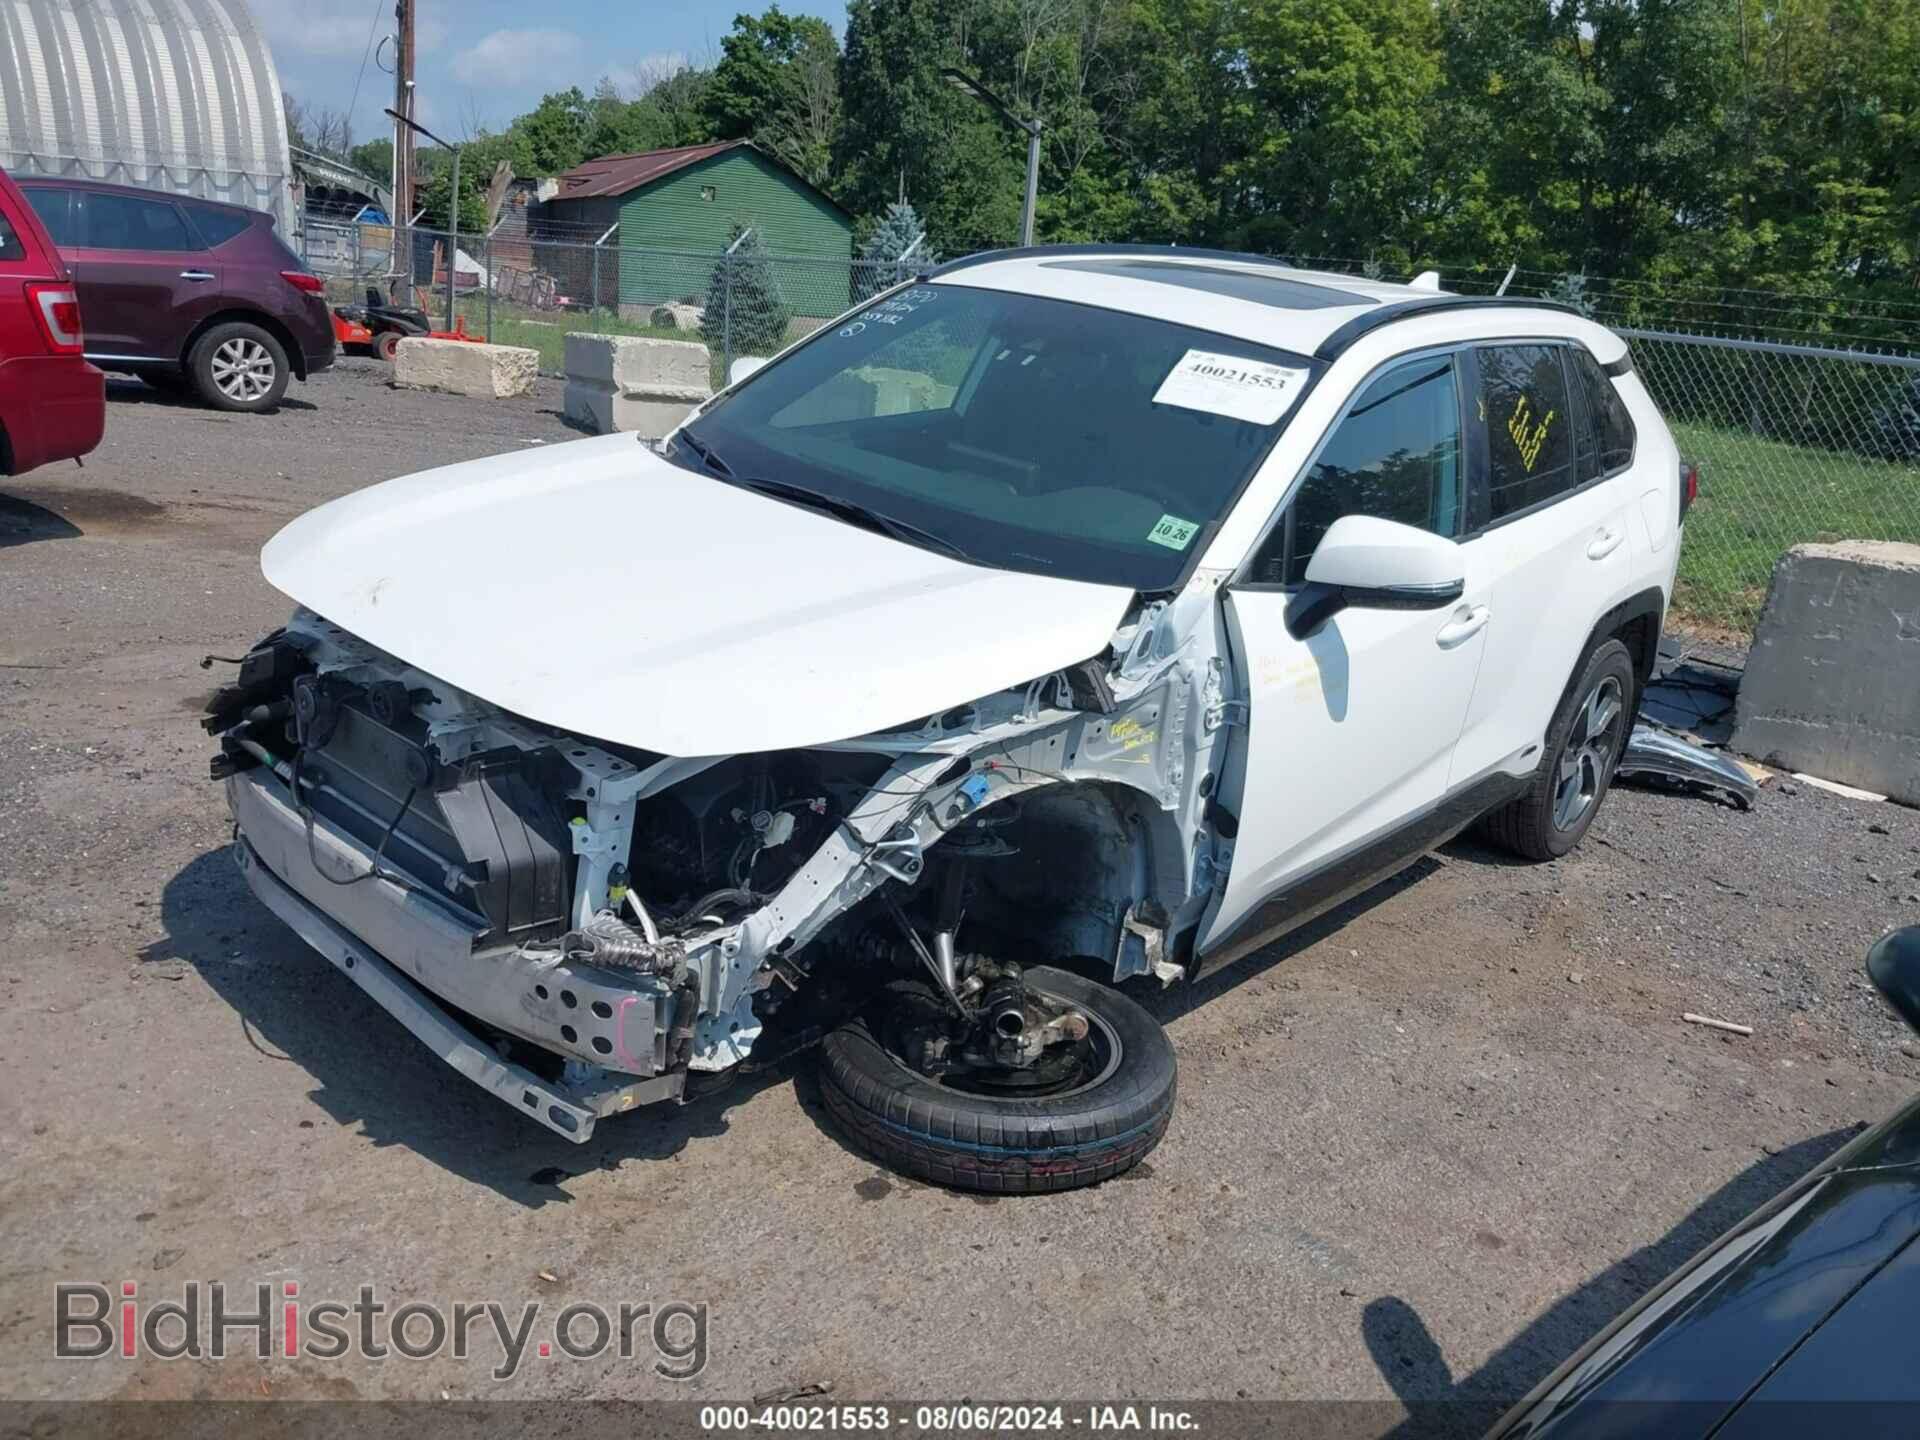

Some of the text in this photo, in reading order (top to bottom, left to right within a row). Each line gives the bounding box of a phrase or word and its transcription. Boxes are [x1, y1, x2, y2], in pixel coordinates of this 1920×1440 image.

[1187, 362, 1287, 391] 40021553
[1155, 522, 1190, 542] 10 26
